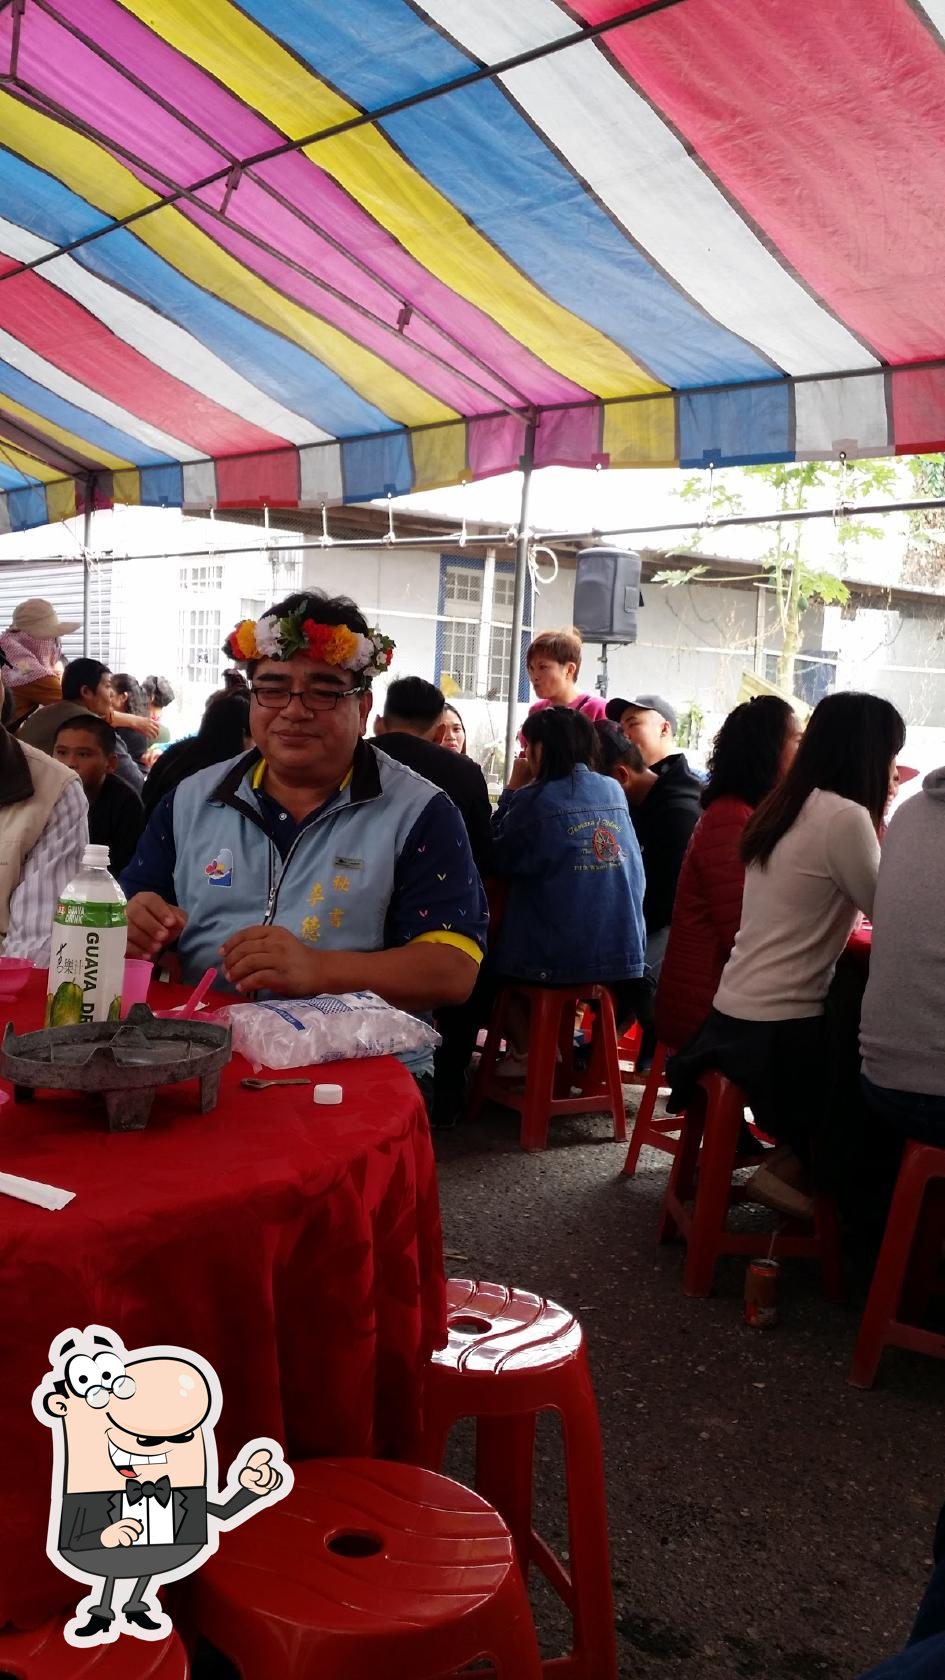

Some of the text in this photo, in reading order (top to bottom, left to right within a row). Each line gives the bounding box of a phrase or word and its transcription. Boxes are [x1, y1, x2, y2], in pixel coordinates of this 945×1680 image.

[68, 905, 85, 916] GUAVA
[65, 914, 84, 925] DRINK
[83, 932, 100, 993] GUAVA
